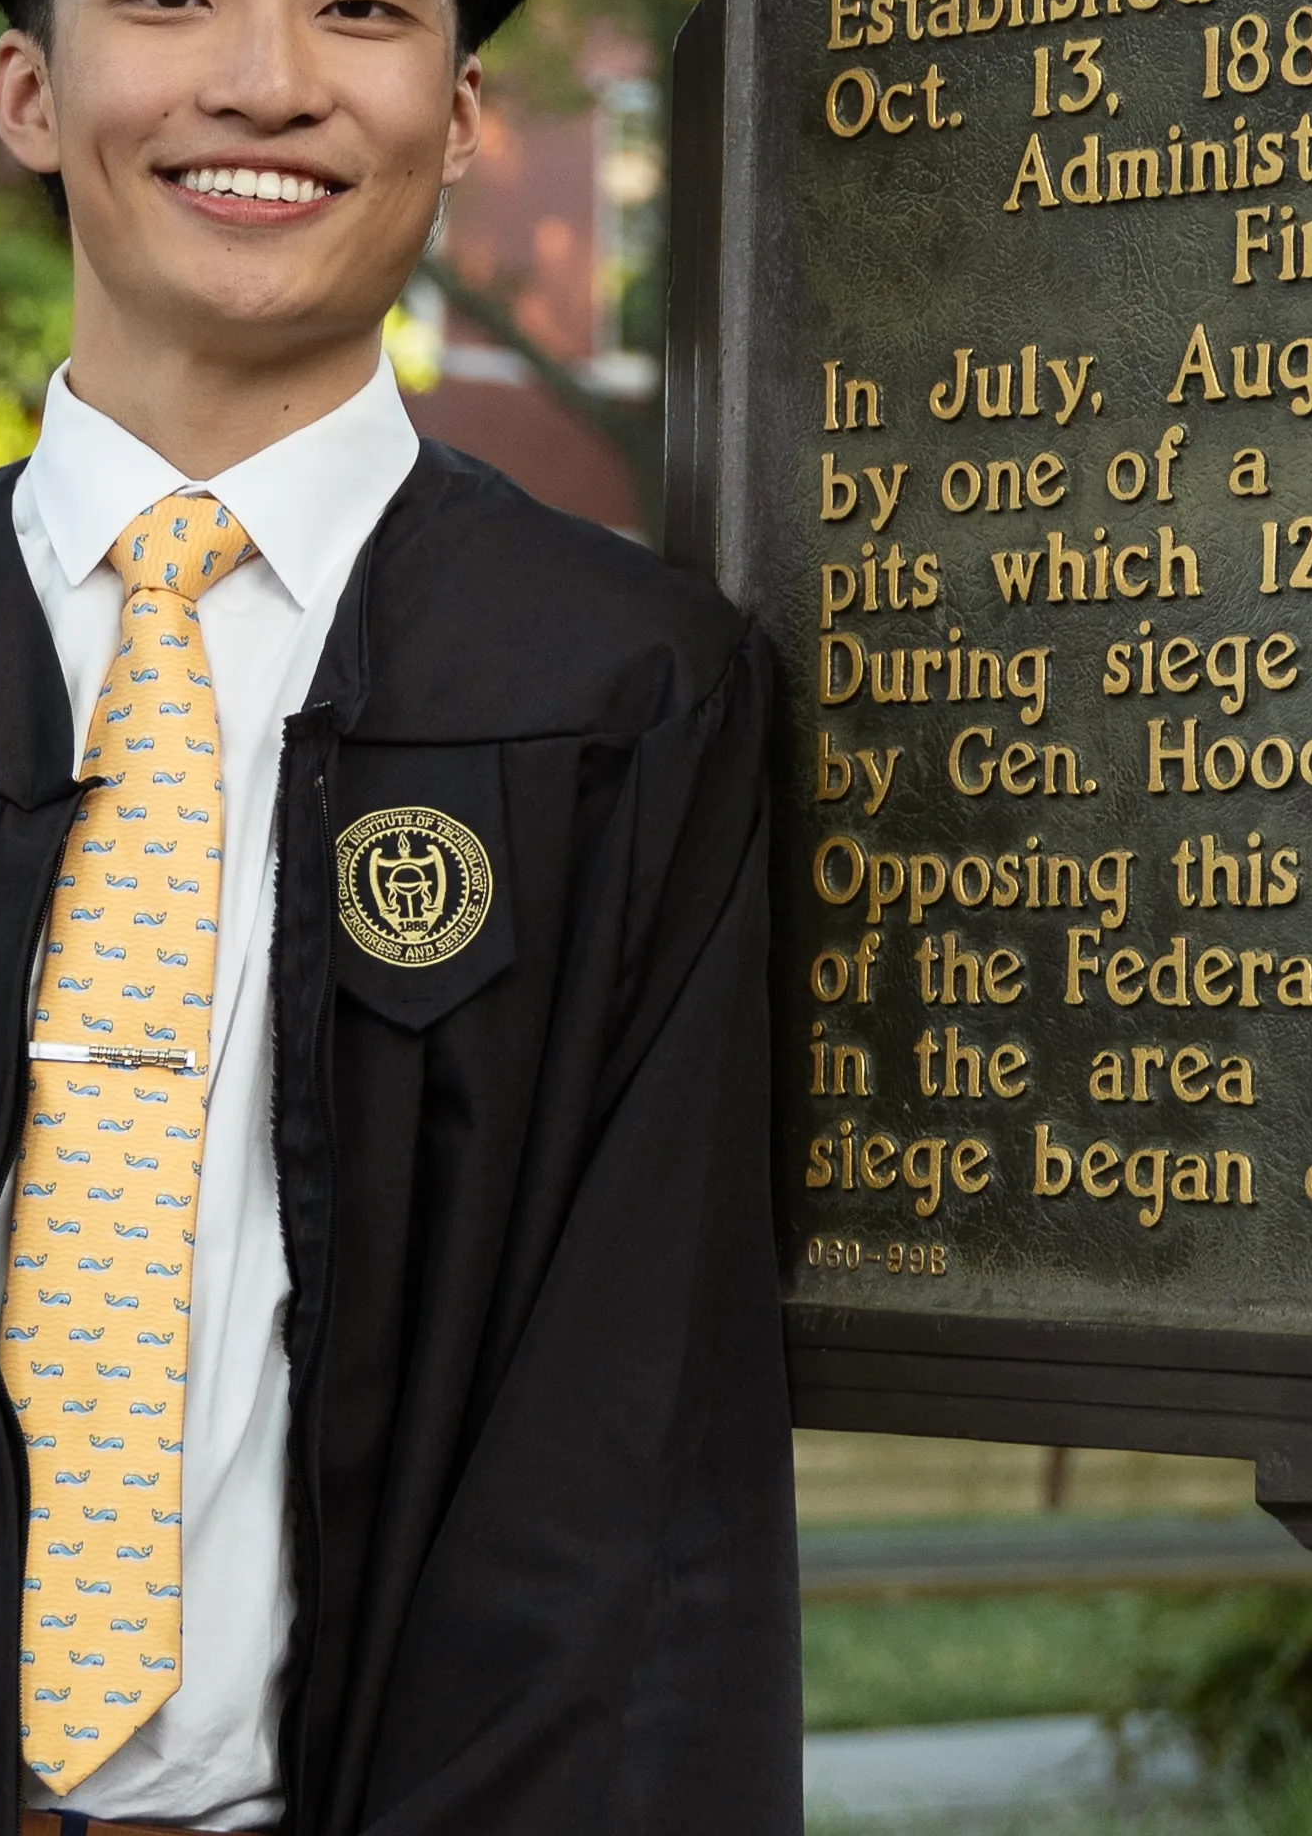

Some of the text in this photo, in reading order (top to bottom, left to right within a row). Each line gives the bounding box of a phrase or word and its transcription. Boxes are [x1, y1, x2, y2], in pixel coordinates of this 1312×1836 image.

[825, 62, 963, 138] Oct.
[1030, 35, 1120, 118] 13,
[822, 359, 881, 431] In
[928, 343, 1104, 426] July,
[818, 451, 910, 533] by
[940, 450, 1067, 513] one
[1105, 423, 1185, 502] of
[1227, 446, 1269, 496] a
[820, 540, 940, 630] pits
[990, 524, 1204, 604] which
[820, 625, 1051, 726] During
[1101, 618, 1299, 716] siege
[817, 731, 899, 815] by
[947, 725, 1098, 796] Gen.
[349, 814, 413, 846] INSTITUTE
[416, 815, 434, 827] OF
[437, 822, 485, 892] TECHNOLOGY
[819, 834, 1135, 930] Opposing
[1170, 830, 1299, 909] this
[346, 903, 479, 960] PROGRESS AND SERVICE
[809, 931, 883, 1006] of
[920, 932, 1023, 1005] the
[809, 1021, 869, 1098] in
[918, 1025, 1027, 1099] the
[1088, 1045, 1256, 1106] area
[805, 1120, 990, 1216] siege
[1032, 1122, 1254, 1228] began
